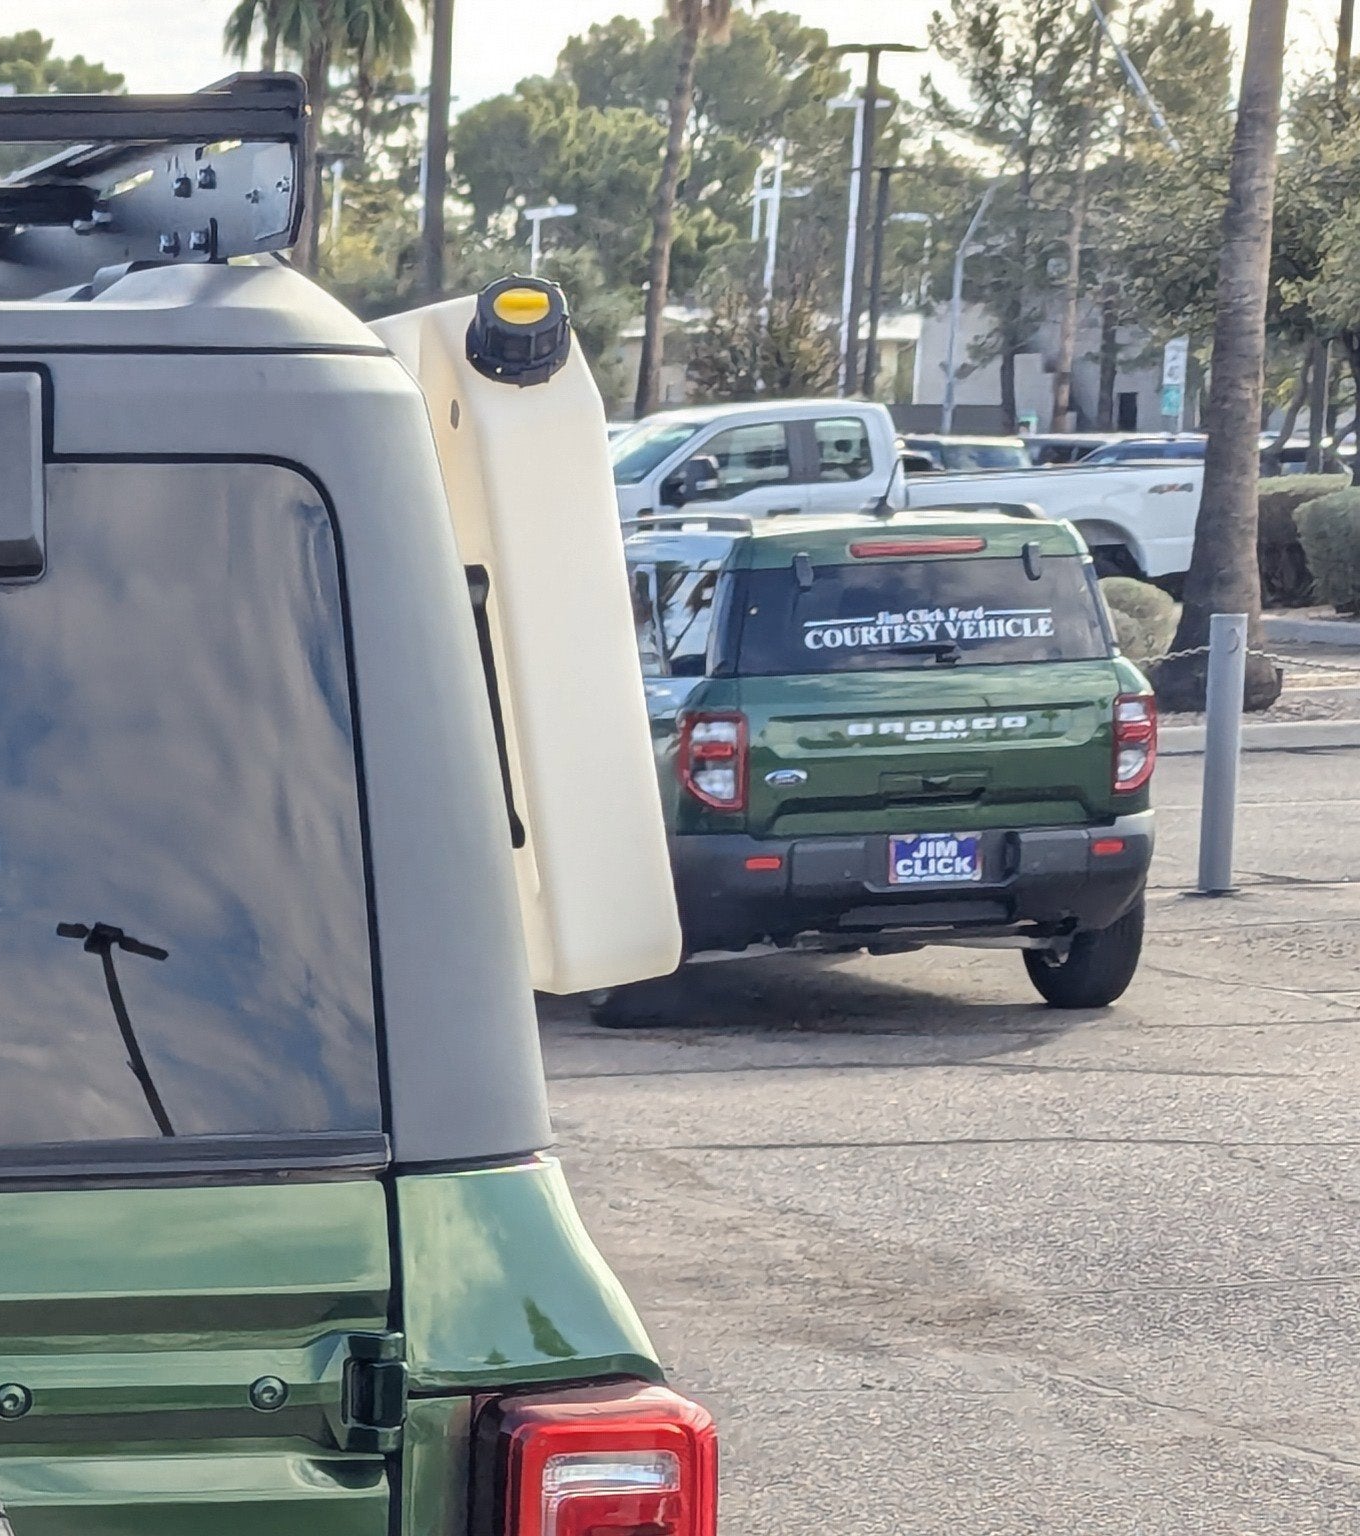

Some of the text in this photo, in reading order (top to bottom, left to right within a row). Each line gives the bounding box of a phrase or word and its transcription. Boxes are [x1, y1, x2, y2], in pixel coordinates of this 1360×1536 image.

[906, 609, 946, 624] Click
[948, 606, 985, 621] Ford
[804, 617, 1055, 650] COURTESY VEHICLE
[847, 715, 1027, 736] BRONCO
[912, 840, 958, 858] JIM
[896, 855, 973, 876] CLICK
